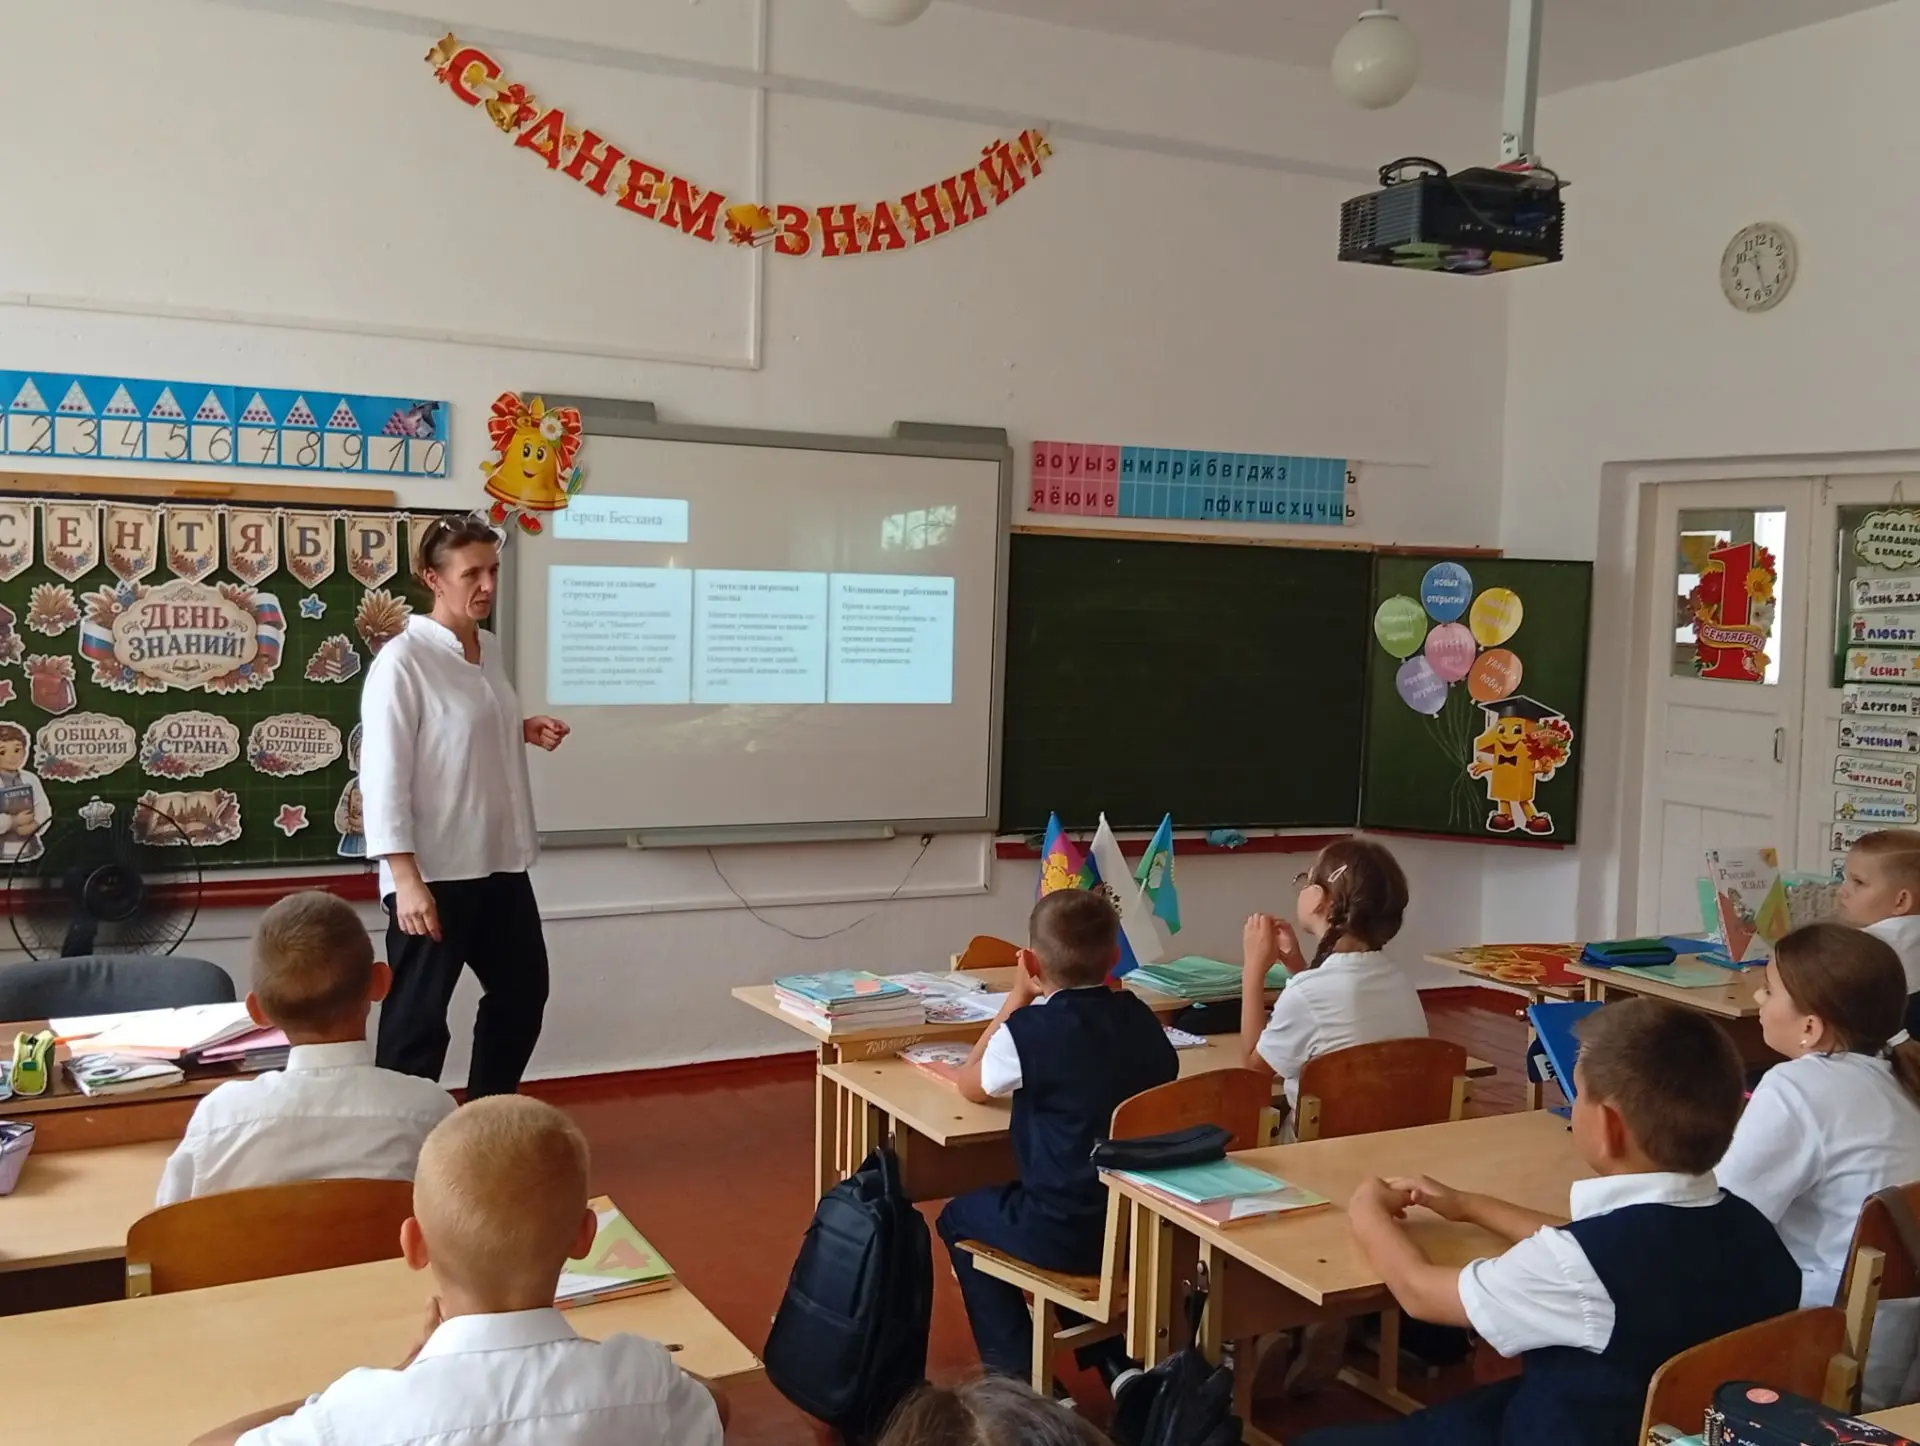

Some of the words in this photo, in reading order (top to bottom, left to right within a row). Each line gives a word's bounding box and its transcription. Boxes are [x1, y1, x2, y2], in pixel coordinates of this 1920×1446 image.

[513, 107, 727, 244] ДНЕМ
[774, 128, 1047, 258] ЗНАНИЙ!
[26, 415, 52, 455] 2
[72, 417, 98, 456] 3
[120, 420, 144, 459] 4
[163, 424, 189, 461] 5
[208, 426, 233, 464] 6
[258, 428, 280, 465] 7
[296, 431, 322, 468] 8
[338, 433, 363, 470] 9
[387, 438, 447, 475] 10
[0, 512, 387, 561] СЕНТЯБР
[1869, 534, 1920, 546] ЗАХОДИШ
[141, 603, 230, 632] ДЕНЬ
[1867, 628, 1916, 641] ЛЮБЯТ
[127, 632, 247, 662] ЗНАНИЙ!
[1861, 701, 1907, 713] ДРУГОМ
[54, 726, 121, 743] ОБЩАЯ
[165, 723, 224, 741] ОДНА
[265, 724, 327, 742] ОБЩЕЕ
[53, 741, 128, 757] ИСТОРИЯ
[157, 739, 229, 755] СТРАНА
[264, 739, 335, 756] БУДУЩЕЕ
